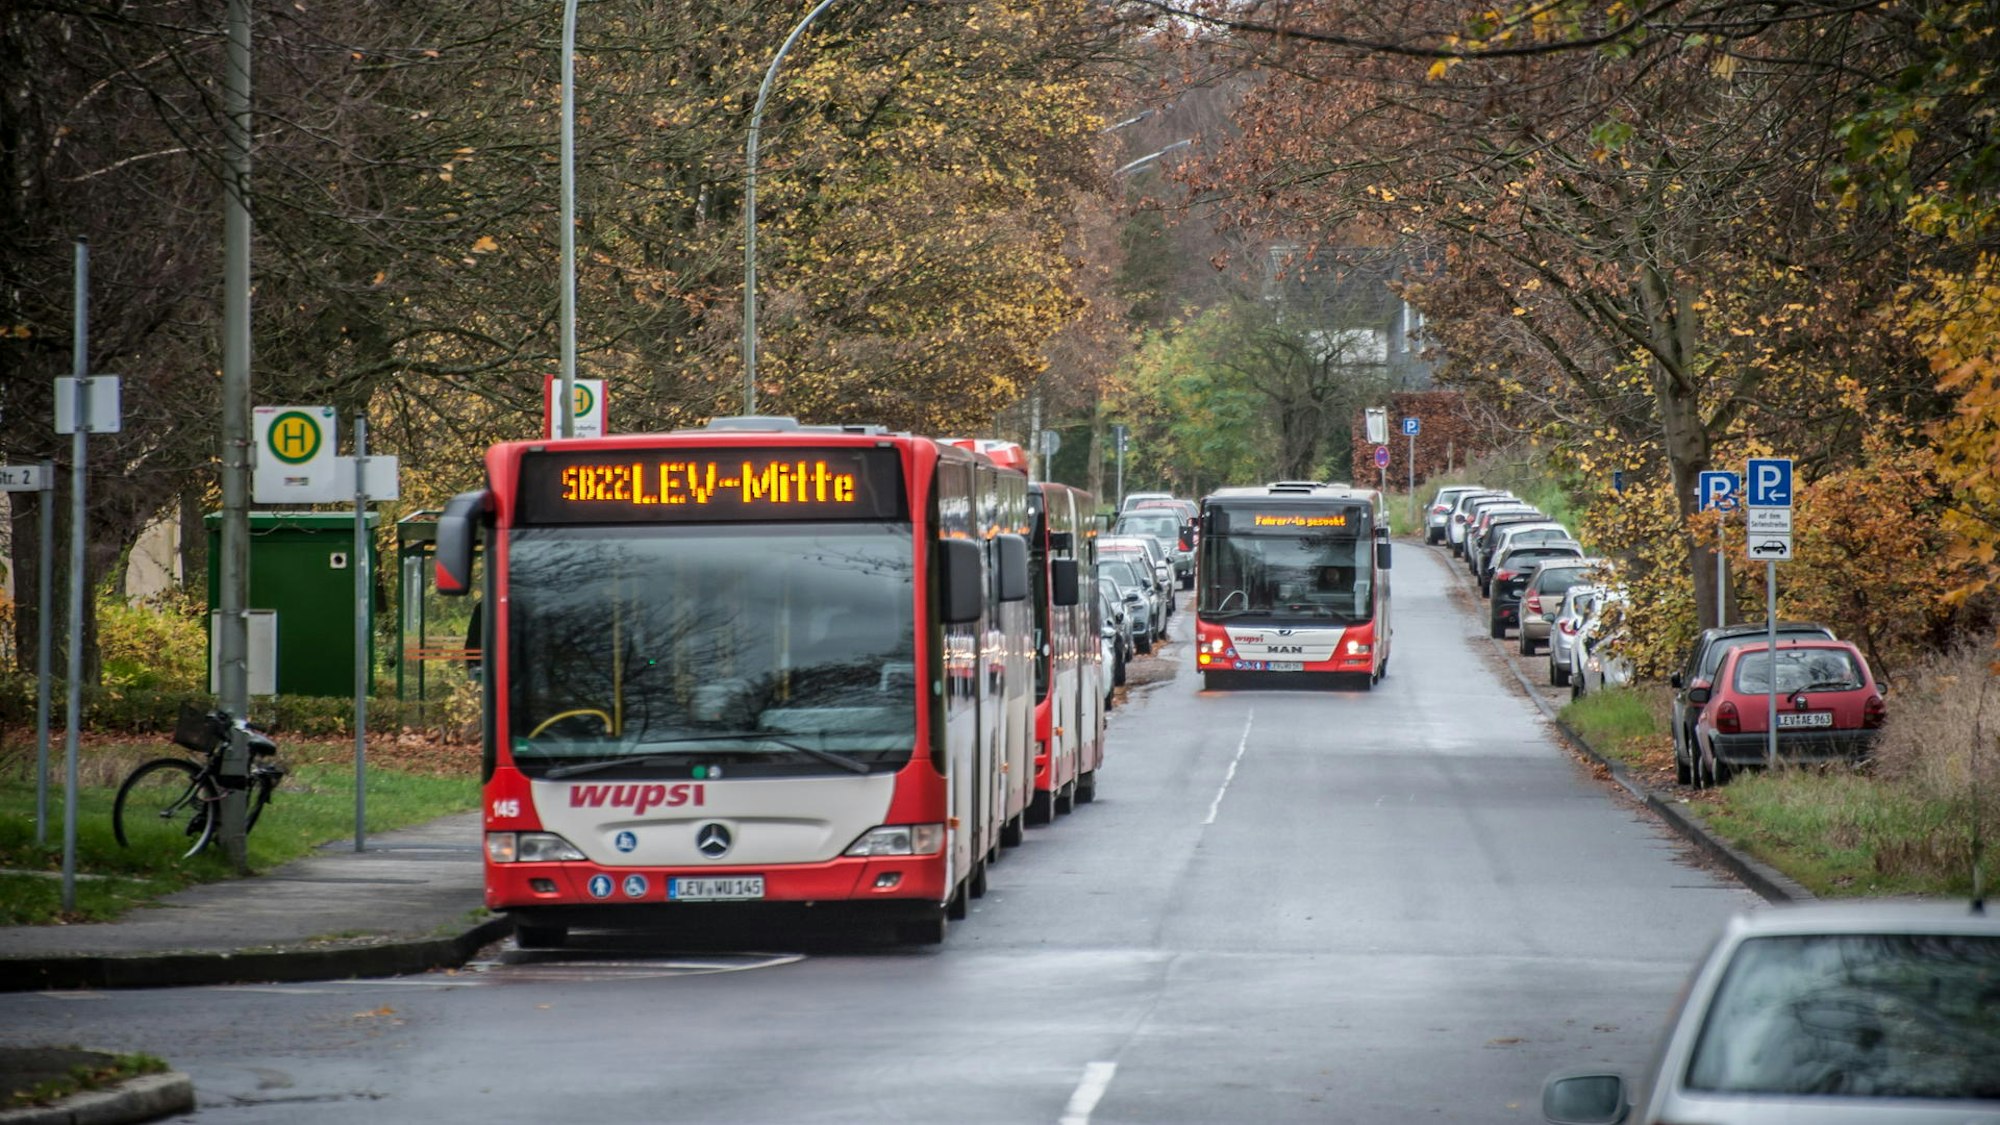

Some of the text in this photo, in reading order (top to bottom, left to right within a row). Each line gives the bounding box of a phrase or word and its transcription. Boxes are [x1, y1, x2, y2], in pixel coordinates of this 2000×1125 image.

[283, 423, 305, 453] H
[23, 469, 31, 485] 2
[562, 460, 855, 504] SB22 LEV-Mitte
[1758, 465, 1781, 500] P
[1234, 634, 1264, 644] wupsi
[492, 800, 520, 817] 145
[569, 784, 705, 815] wupsi
[677, 880, 703, 897] LEV
[735, 877, 761, 896] 145
